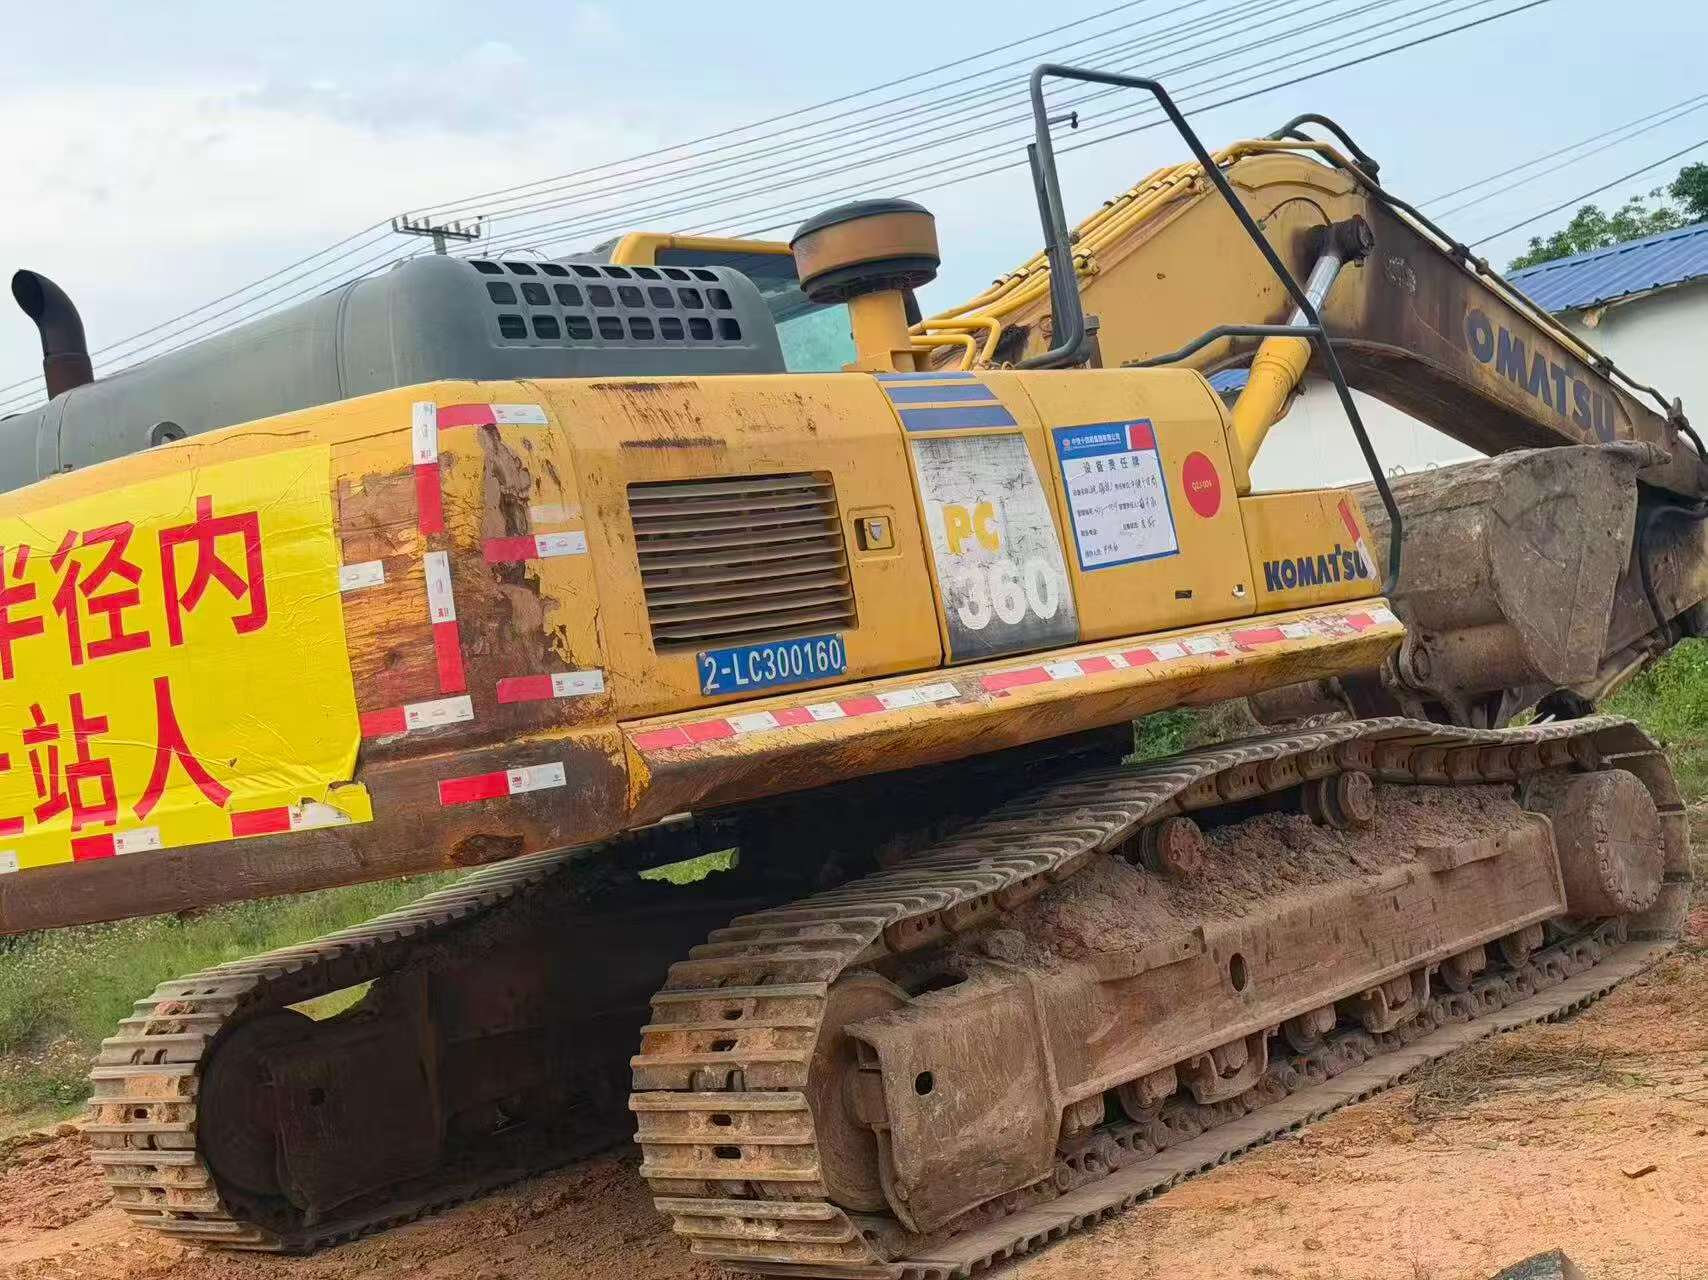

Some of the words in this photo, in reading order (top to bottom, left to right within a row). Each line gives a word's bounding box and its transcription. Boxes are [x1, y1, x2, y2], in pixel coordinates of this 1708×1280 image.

[943, 502, 1001, 556] PC
[955, 558, 1060, 630] 360
[1263, 544, 1369, 592] KOMATSU
[704, 639, 841, 690] 2-LC300160
